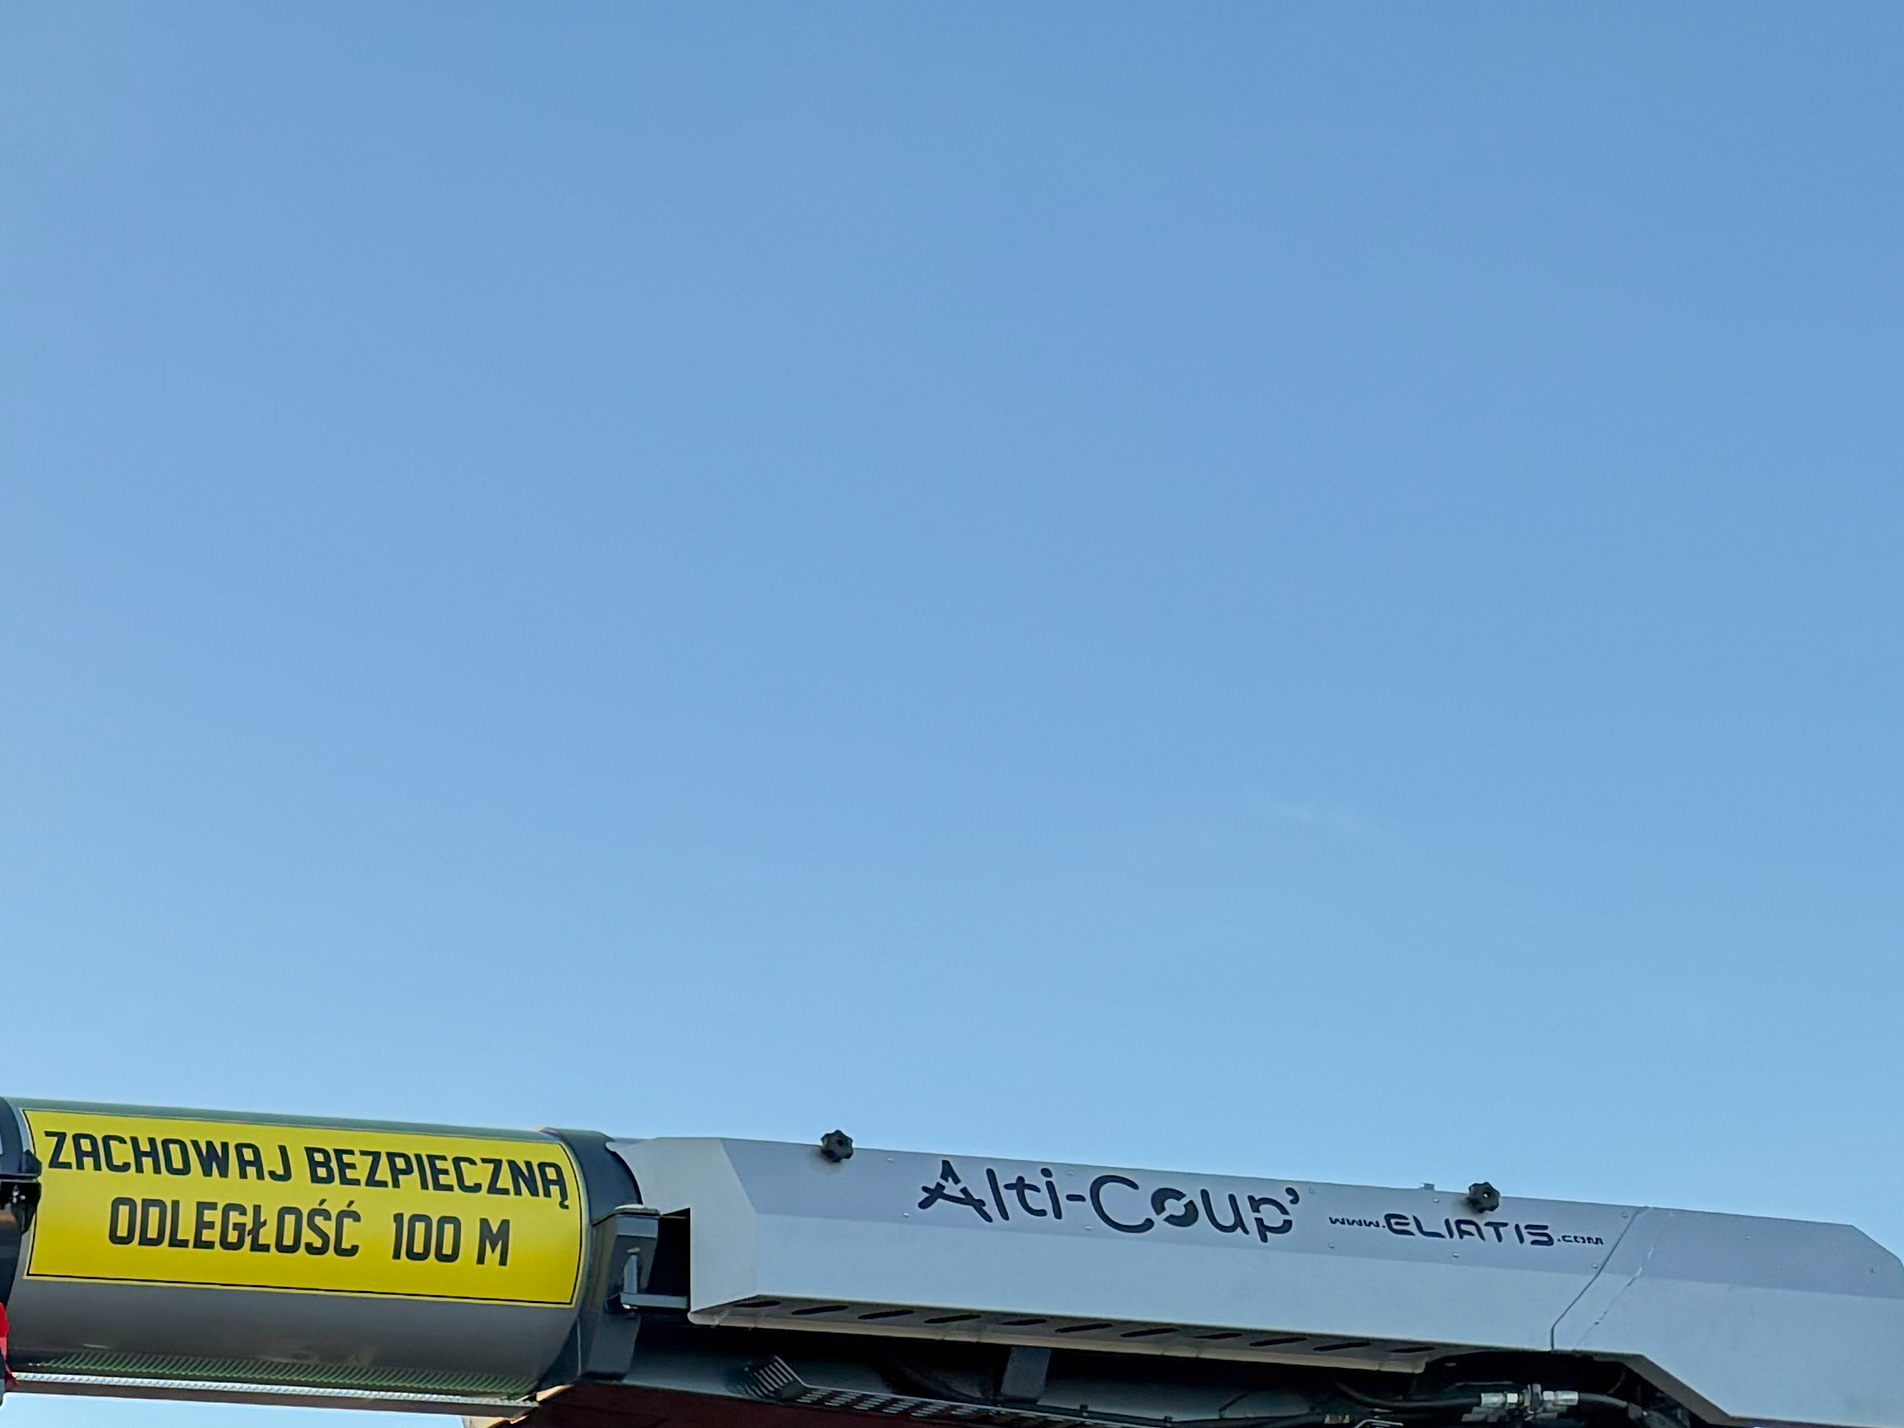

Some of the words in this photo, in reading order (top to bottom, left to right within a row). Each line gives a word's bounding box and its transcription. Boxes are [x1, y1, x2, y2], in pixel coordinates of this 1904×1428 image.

[43, 1129, 293, 1183] ZACHOWAJ
[303, 1145, 570, 1210] BEZPIECZNĄ
[108, 1196, 362, 1258] ODLEGŁOŚĆ
[391, 1212, 463, 1264] 100
[475, 1216, 511, 1267] M
